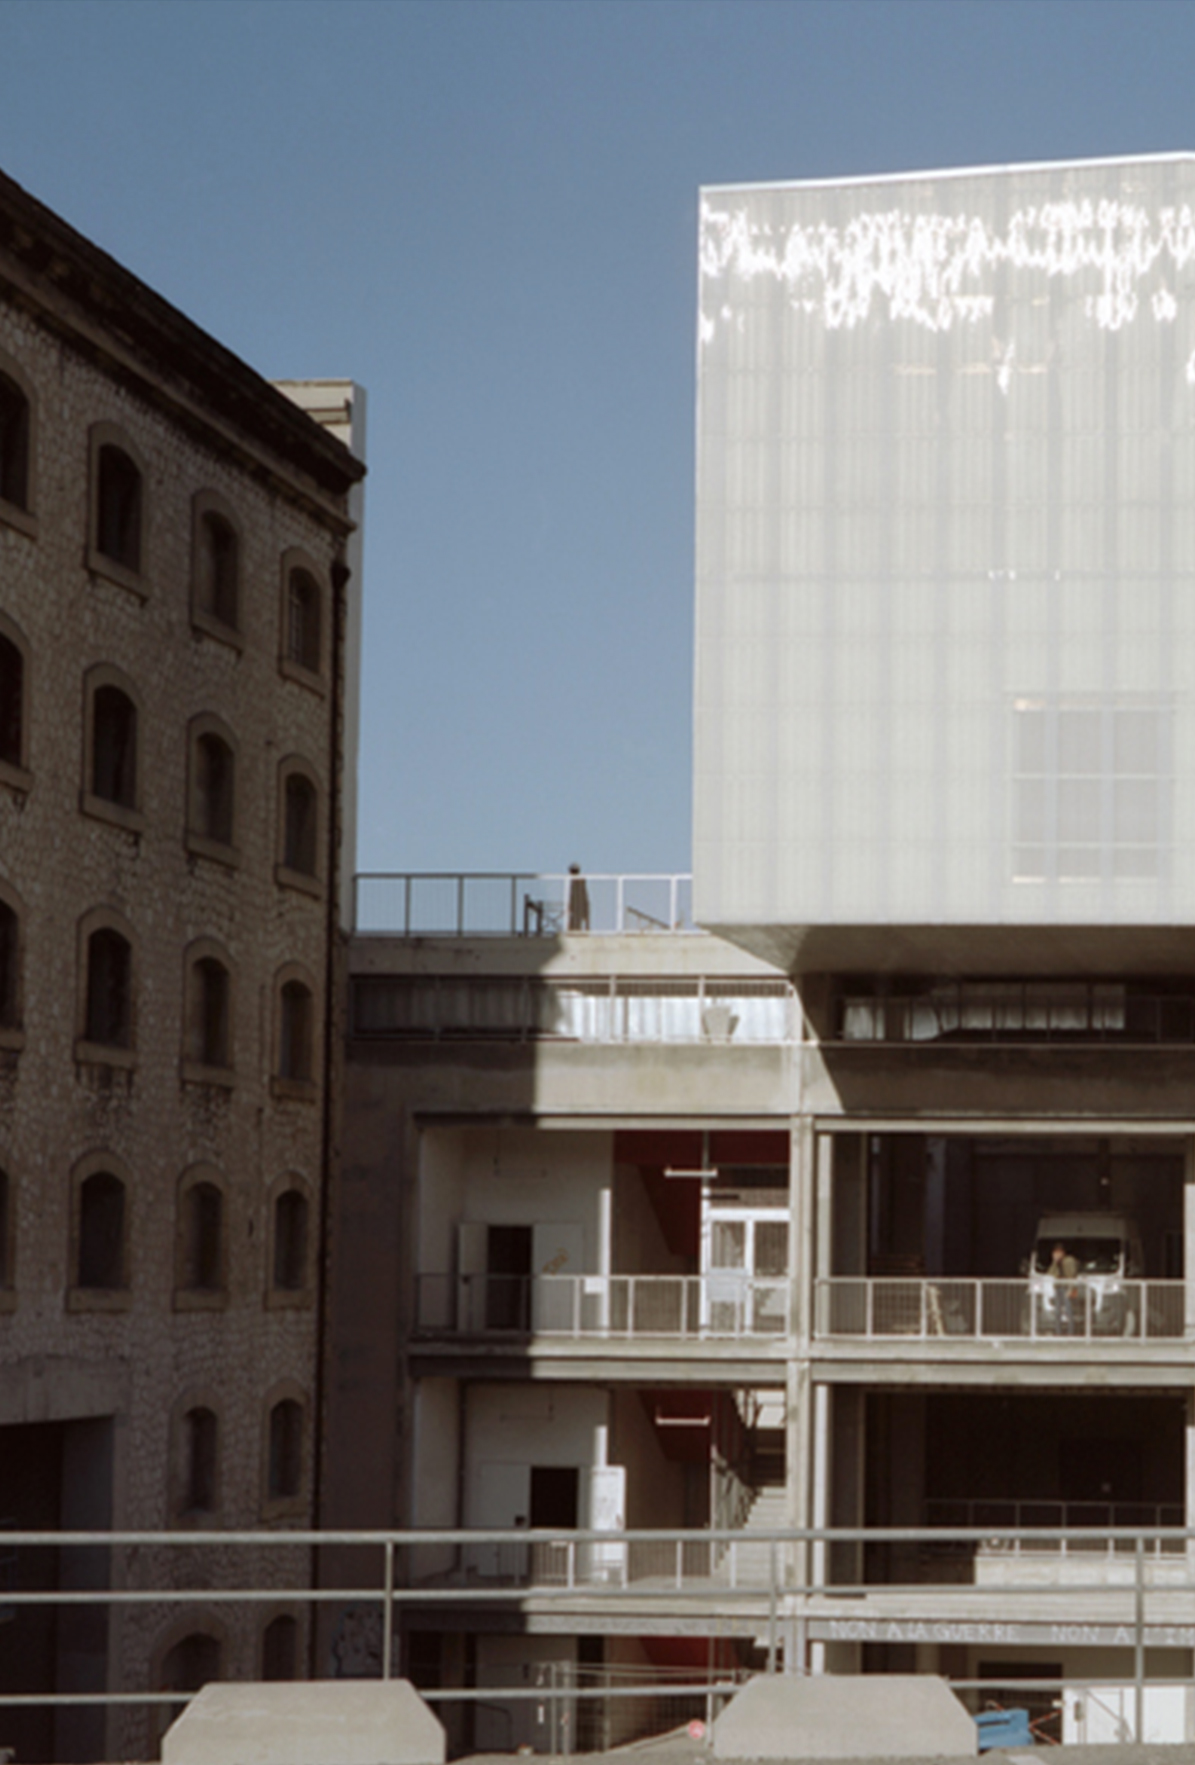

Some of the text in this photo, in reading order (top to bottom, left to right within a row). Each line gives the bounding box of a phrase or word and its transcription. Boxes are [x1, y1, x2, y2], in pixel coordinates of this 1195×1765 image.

[829, 1620, 877, 1639] NON
[887, 1621, 904, 1640] A
[933, 1623, 1020, 1642] GUERRE
[1051, 1625, 1100, 1642] NON
[1112, 1626, 1131, 1644] A
